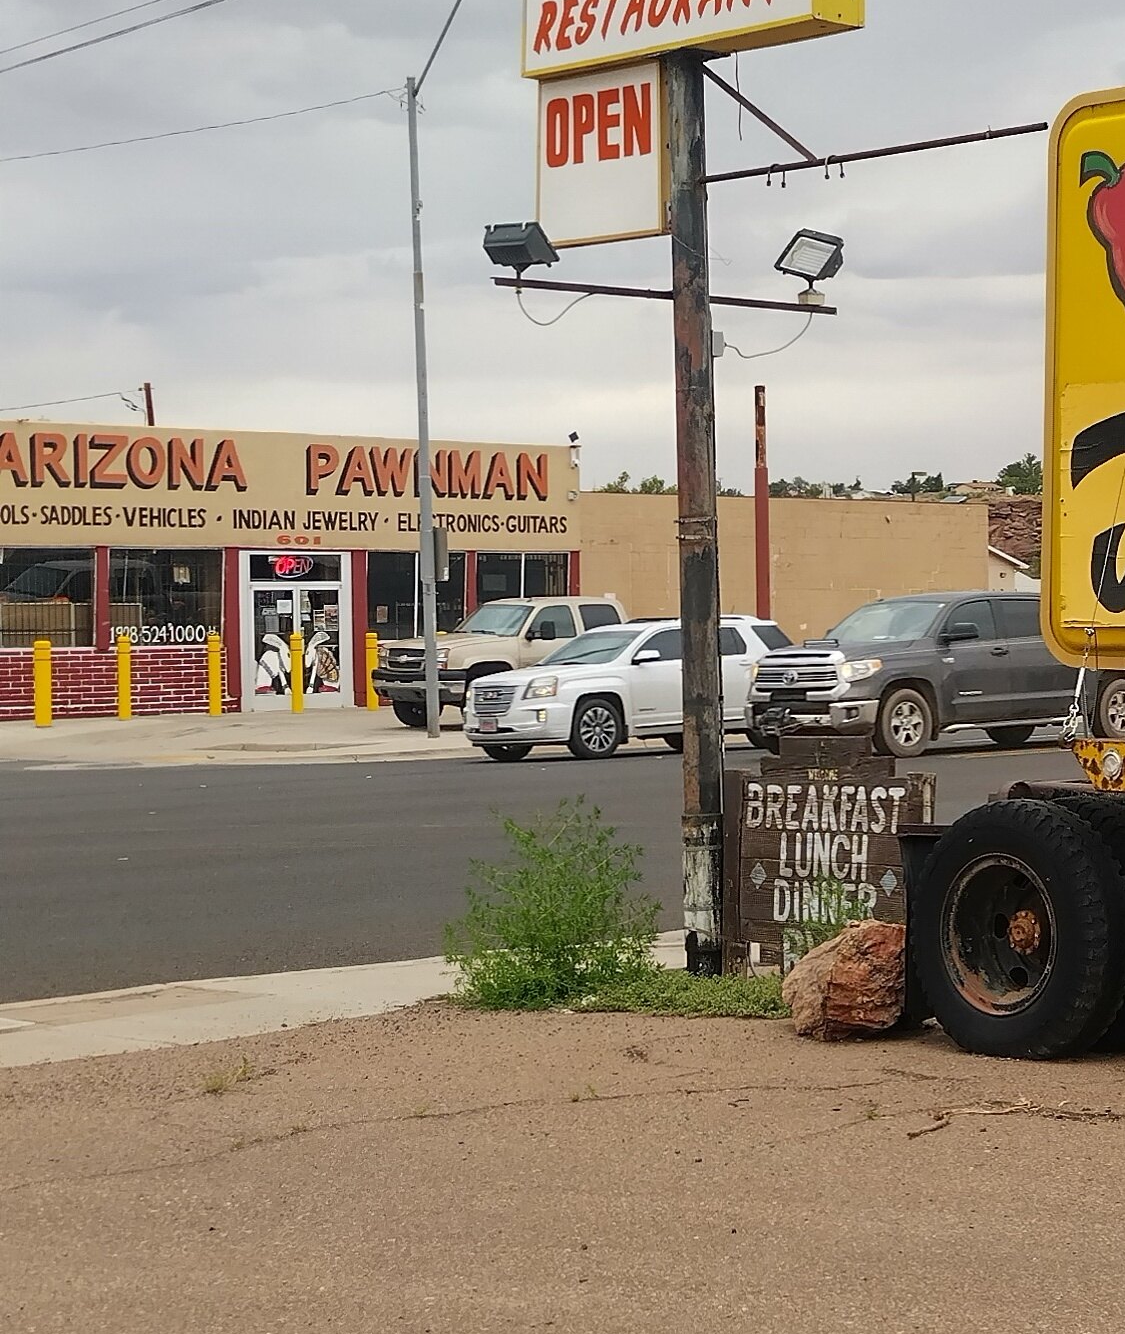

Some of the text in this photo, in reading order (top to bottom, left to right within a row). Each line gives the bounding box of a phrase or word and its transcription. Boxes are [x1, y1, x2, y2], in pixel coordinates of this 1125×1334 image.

[546, 83, 651, 168] OPEN
[0, 432, 548, 501] ARIZONA PAWNMAN
[233, 509, 295, 530] INDIAN
[303, 511, 378, 532] JEWELRY
[277, 535, 321, 545] 601
[276, 556, 310, 575] OPEN
[746, 782, 906, 834] BREAKFAST
[778, 832, 869, 881] LUNCH
[773, 878, 878, 925] DINNER
